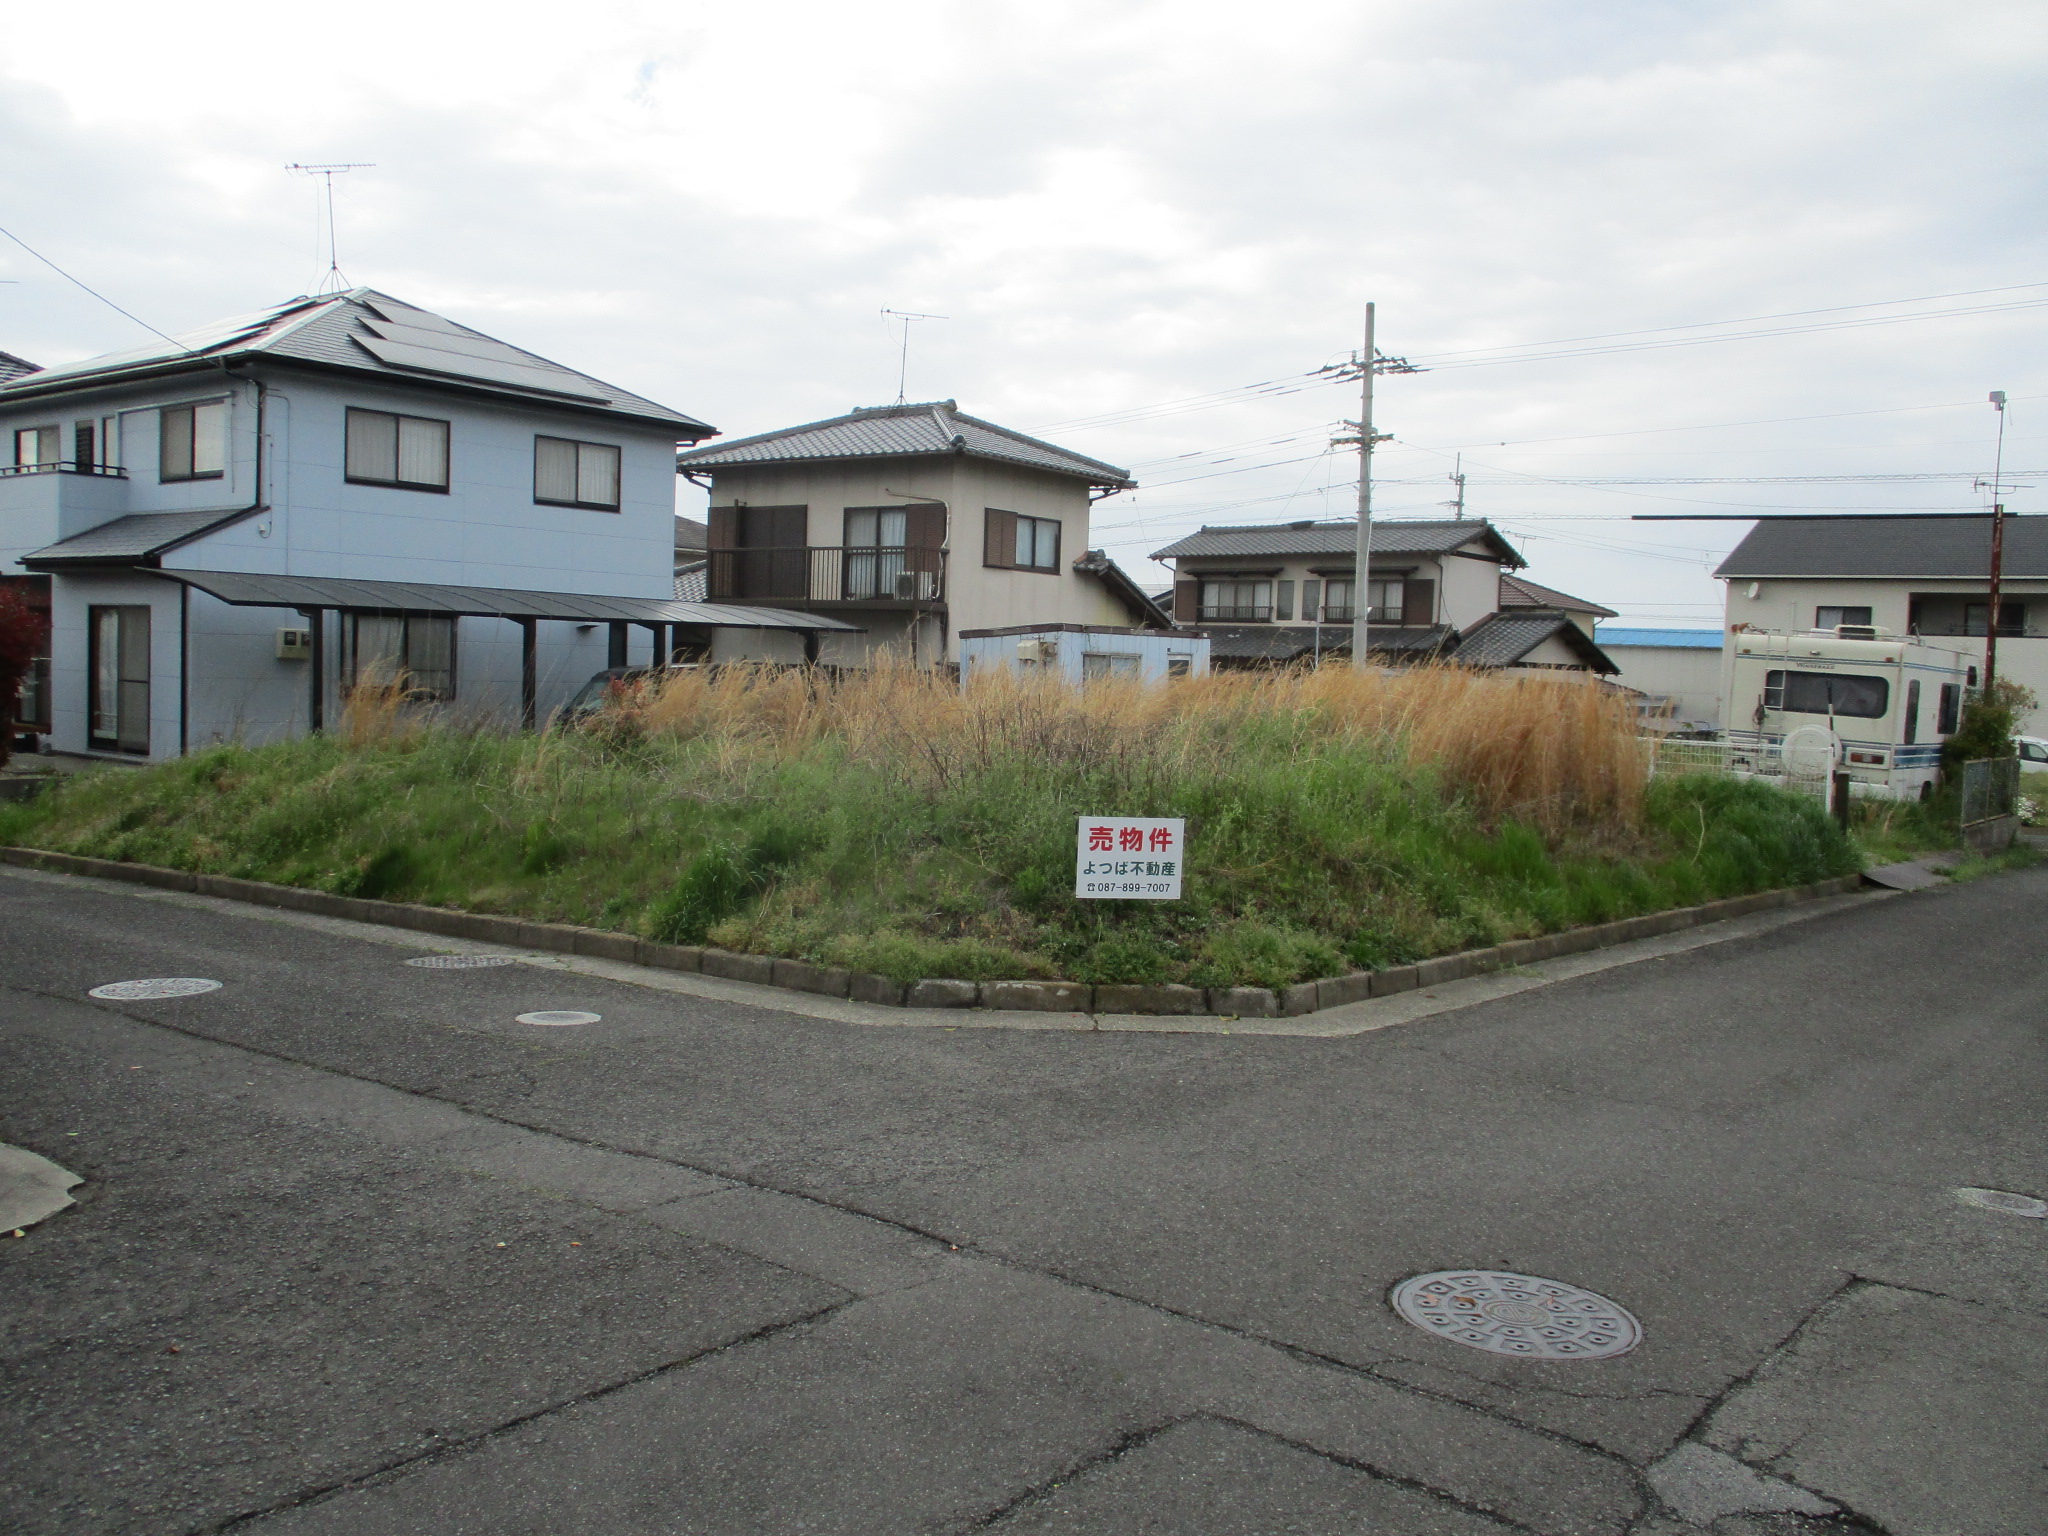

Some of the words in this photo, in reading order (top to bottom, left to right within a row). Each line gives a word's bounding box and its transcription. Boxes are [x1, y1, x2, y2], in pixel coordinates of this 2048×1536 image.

[1089, 826, 1173, 852] 売物件
[1083, 861, 1176, 876] よつば不動産
[1097, 883, 1170, 892] 087-899-7007
